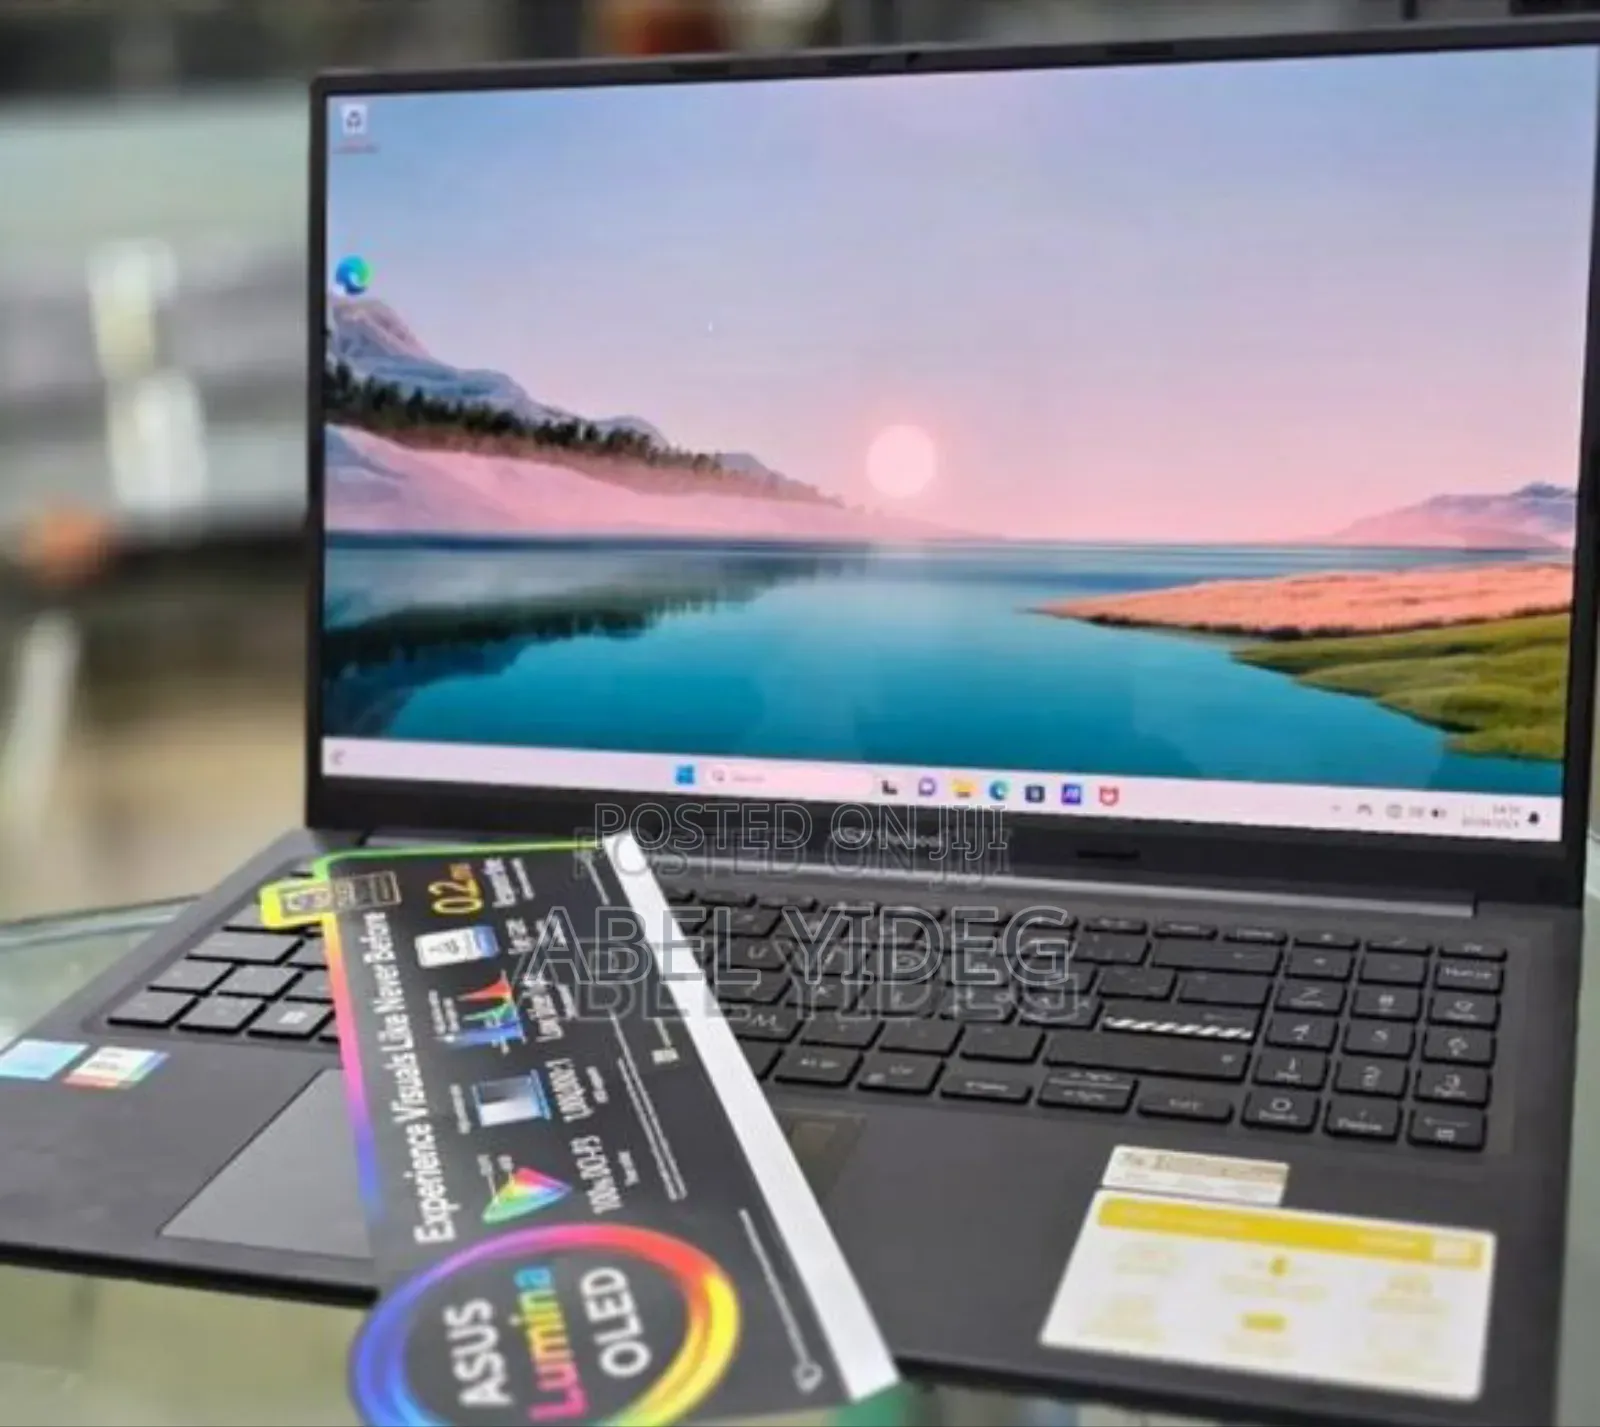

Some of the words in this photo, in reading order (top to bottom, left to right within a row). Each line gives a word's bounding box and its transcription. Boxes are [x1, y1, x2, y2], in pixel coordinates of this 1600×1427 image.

[360, 911, 397, 964] Before
[373, 964, 406, 1013] Never
[376, 1013, 414, 1052] Like
[383, 1052, 429, 1122] Visuals
[404, 1122, 461, 1245] Experience
[443, 1298, 514, 1407] ASUS
[508, 1264, 590, 1421] Lumina
[580, 1266, 652, 1379] OLED
